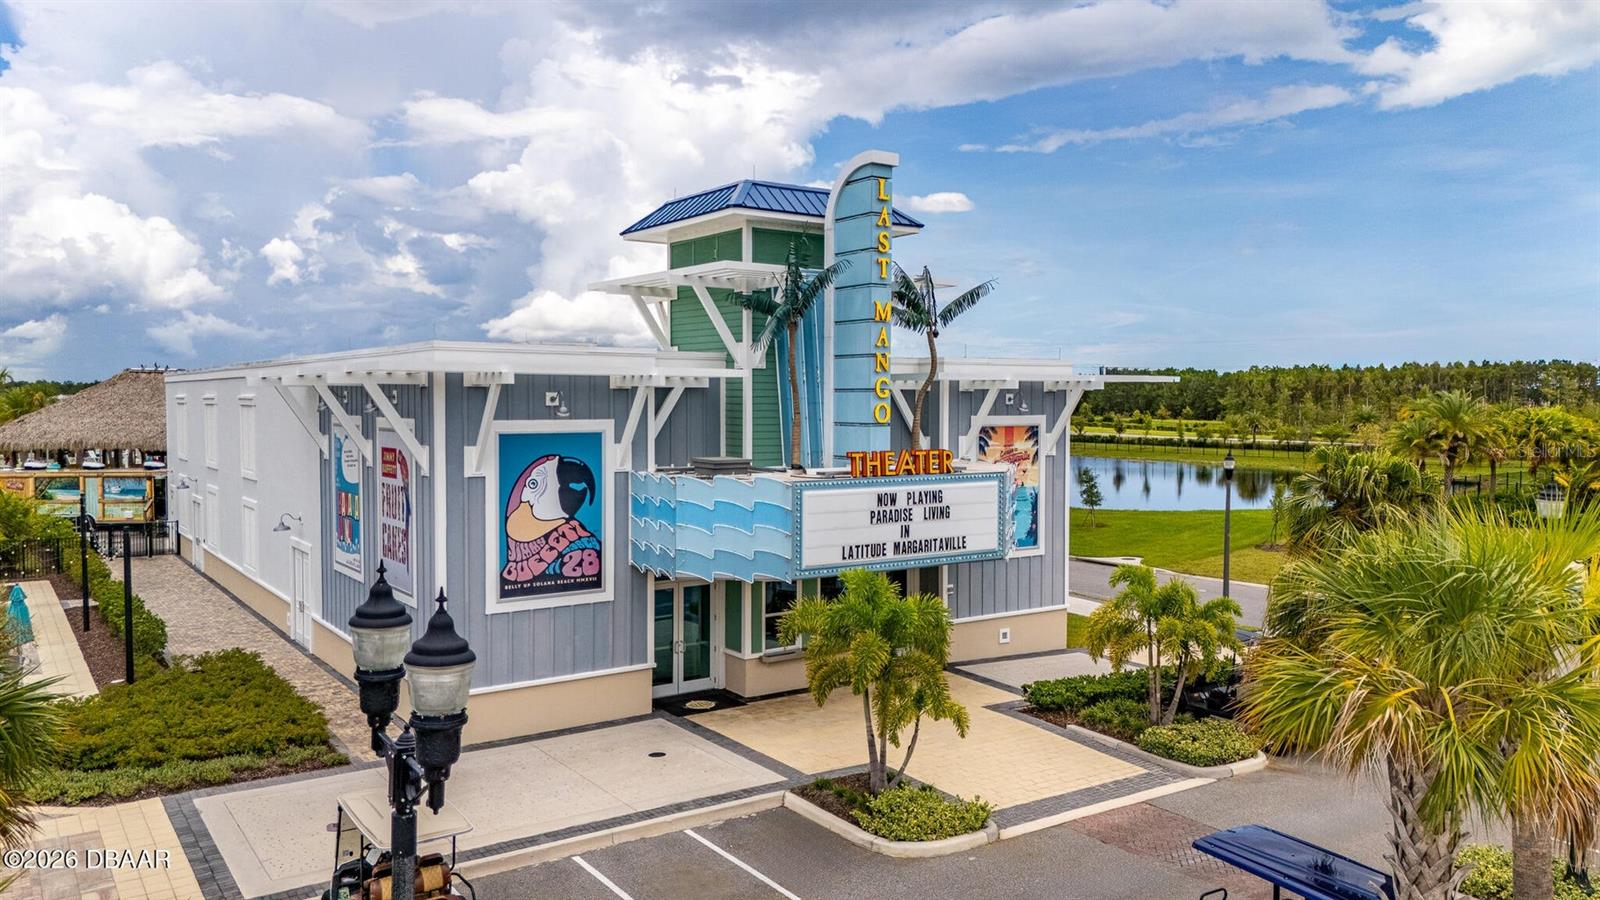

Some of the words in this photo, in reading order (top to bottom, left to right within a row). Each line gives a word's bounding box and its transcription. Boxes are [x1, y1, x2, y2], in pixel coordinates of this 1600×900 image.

[876, 178, 891, 280] LAST
[874, 301, 892, 424] MANGO
[847, 448, 955, 478] THEATER
[381, 482, 405, 523] FRUIT
[877, 492, 897, 507] NOW
[907, 490, 943, 506] PLAYING
[870, 508, 913, 525] PARADISE
[923, 505, 951, 521] LIVING
[382, 522, 407, 565] CAKES
[900, 525, 910, 538] IN
[507, 537, 546, 562] JIMMY
[842, 543, 887, 561] LATITUDE
[893, 536, 967, 556] MARGARITAVILLE
[562, 549, 600, 577] 28
